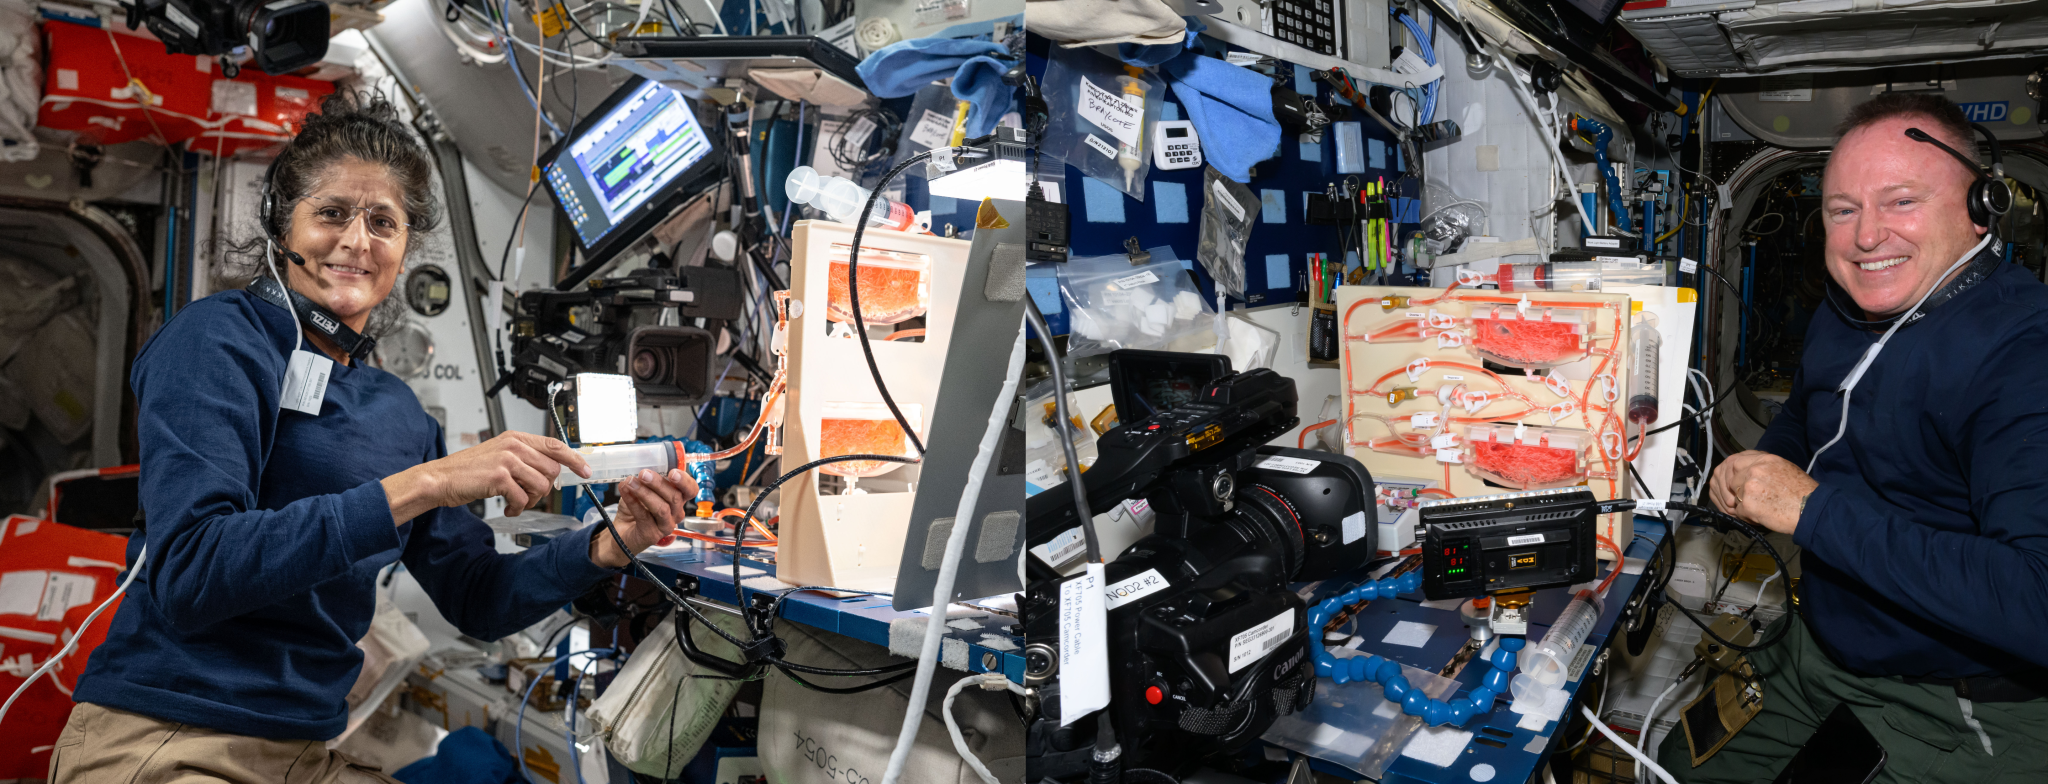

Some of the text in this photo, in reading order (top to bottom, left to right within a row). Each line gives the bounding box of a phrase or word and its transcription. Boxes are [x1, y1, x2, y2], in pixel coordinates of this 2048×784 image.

[1946, 272, 1979, 299] TIKKA
[311, 310, 340, 335] PETZL
[434, 364, 463, 380] COL
[1444, 548, 1456, 556] 81
[1451, 558, 1463, 566] 81
[1086, 576, 1094, 590] P1
[1106, 575, 1159, 602] NOD2 #2
[1063, 584, 1072, 666] To XF705 Camcorder
[1074, 607, 1082, 631] Power
[1074, 633, 1082, 655] Cable
[1235, 624, 1269, 643] XF705 Camcorder
[1233, 654, 1241, 663] S/N
[1274, 646, 1304, 680] Canon
